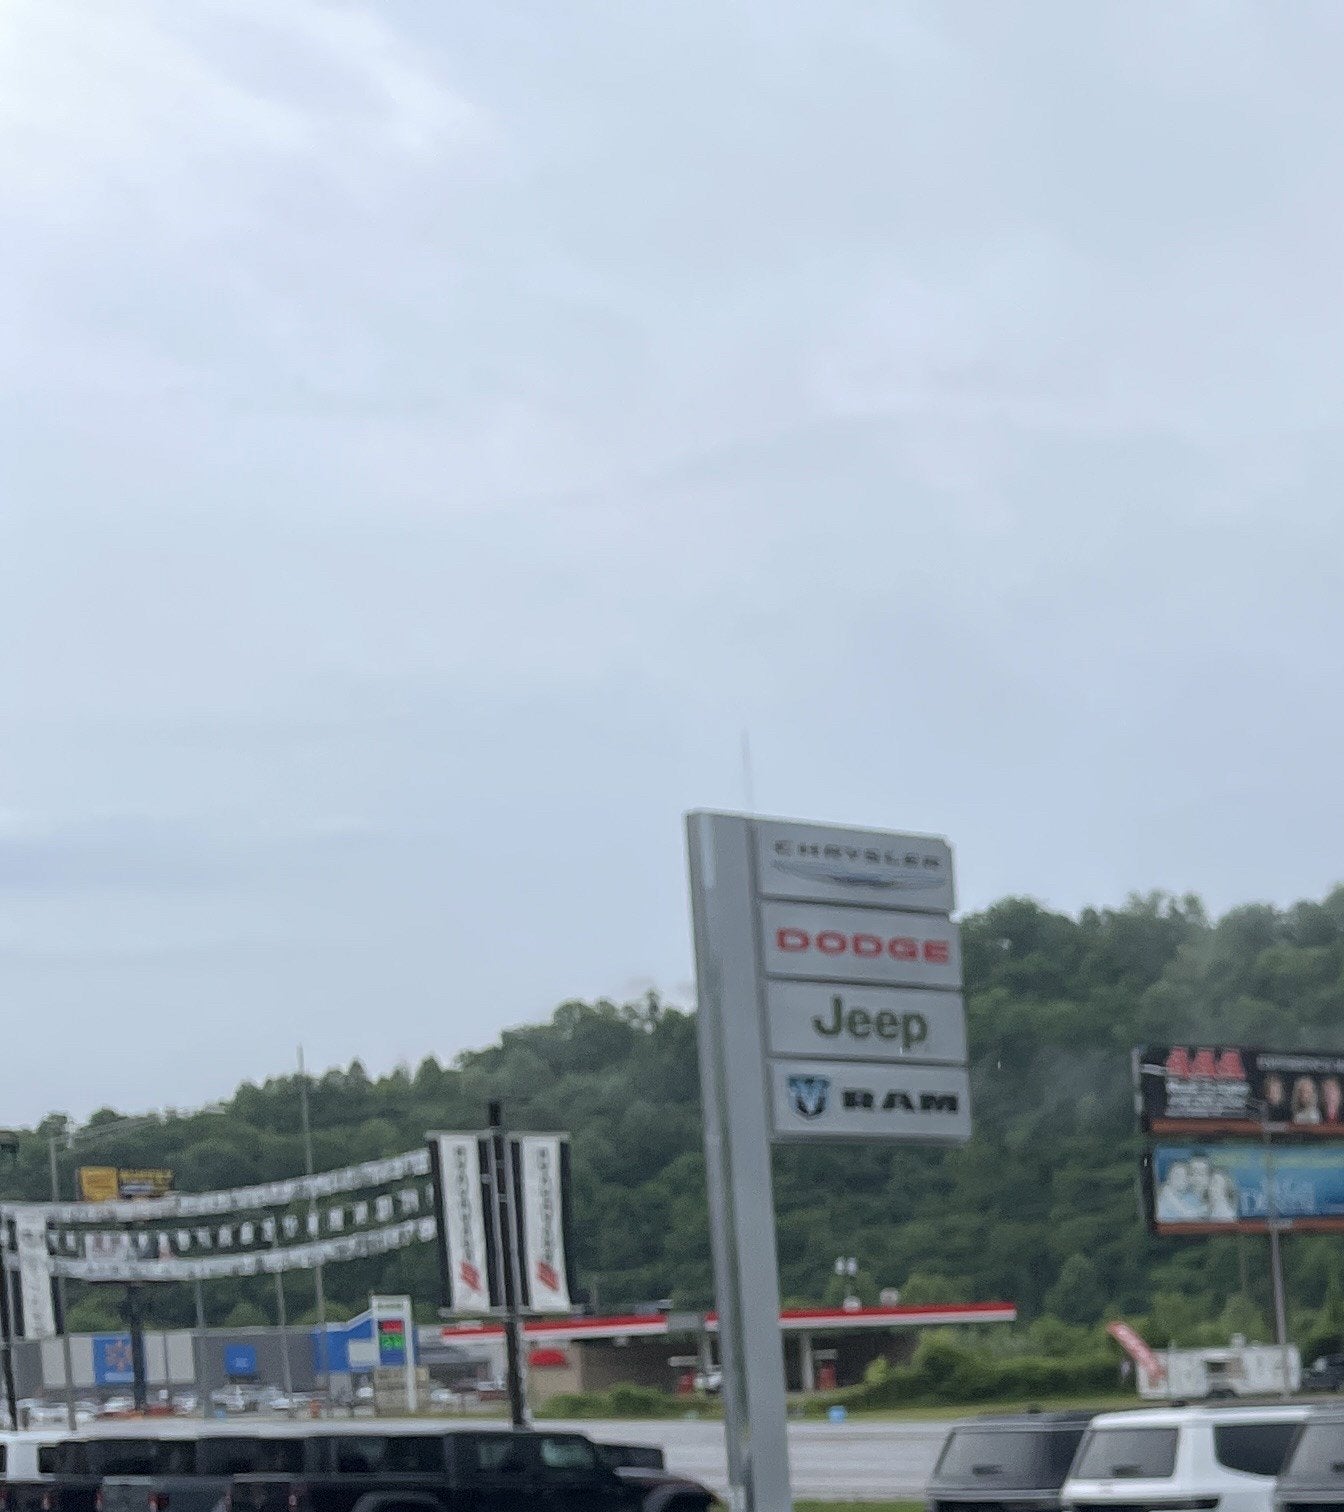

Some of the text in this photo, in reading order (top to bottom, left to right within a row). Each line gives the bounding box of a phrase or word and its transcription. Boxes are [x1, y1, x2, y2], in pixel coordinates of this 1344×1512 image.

[775, 841, 941, 868] CHRYSLER
[777, 928, 950, 963] DODGE
[813, 995, 927, 1048] Jeep
[842, 1088, 958, 1113] RAM
